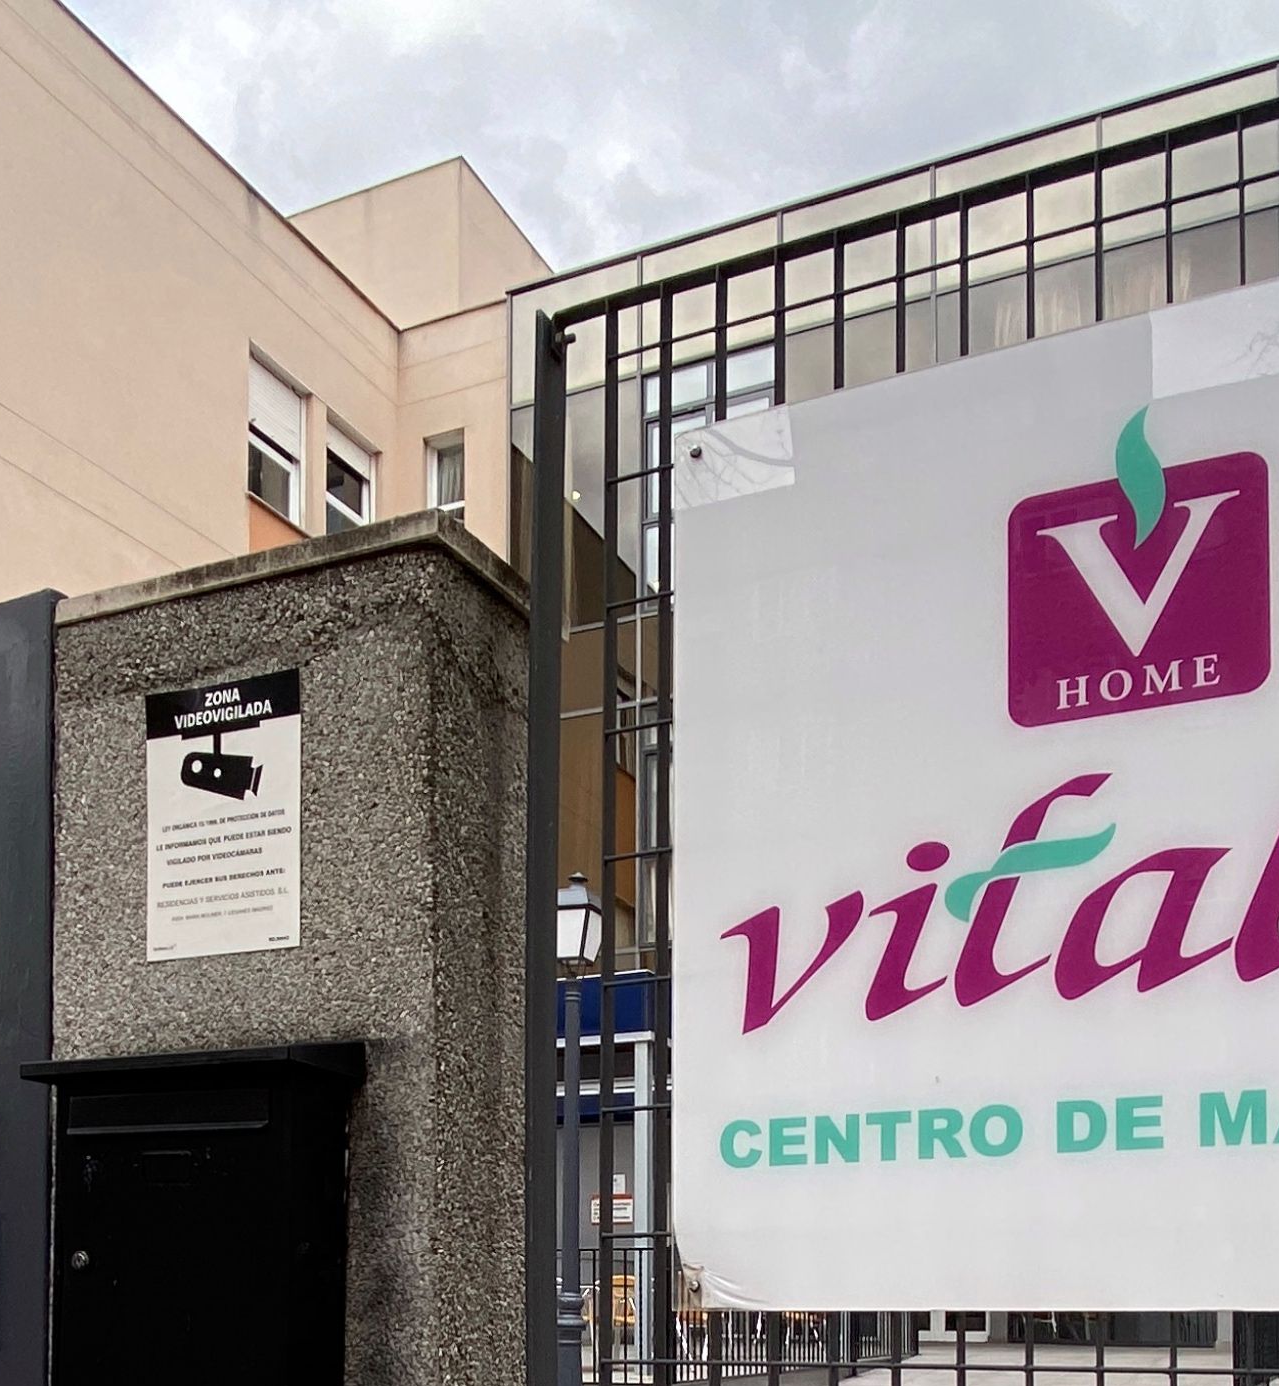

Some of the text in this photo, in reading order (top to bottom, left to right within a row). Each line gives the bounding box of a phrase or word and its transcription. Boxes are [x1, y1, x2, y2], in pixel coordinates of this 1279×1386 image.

[1055, 652, 1221, 711] HOME
[205, 688, 240, 707] ZONA
[174, 699, 272, 729] VIDEOVIGILADA
[165, 839, 206, 850] INFORMAMOS
[208, 837, 221, 845] QUE
[224, 833, 244, 842] PUEDE
[246, 830, 265, 839] ESTAR
[267, 826, 292, 836] SIENDO
[167, 855, 196, 865] VIGILADO
[197, 854, 211, 862] POR
[185, 877, 213, 886] EJERCER
[229, 871, 264, 881] DERECHOS
[157, 898, 198, 908] RESIDENCIAS
[205, 893, 239, 903] SERVICIOS
[718, 1103, 1024, 1170] CENTRO
[1055, 1093, 1165, 1154] DE
